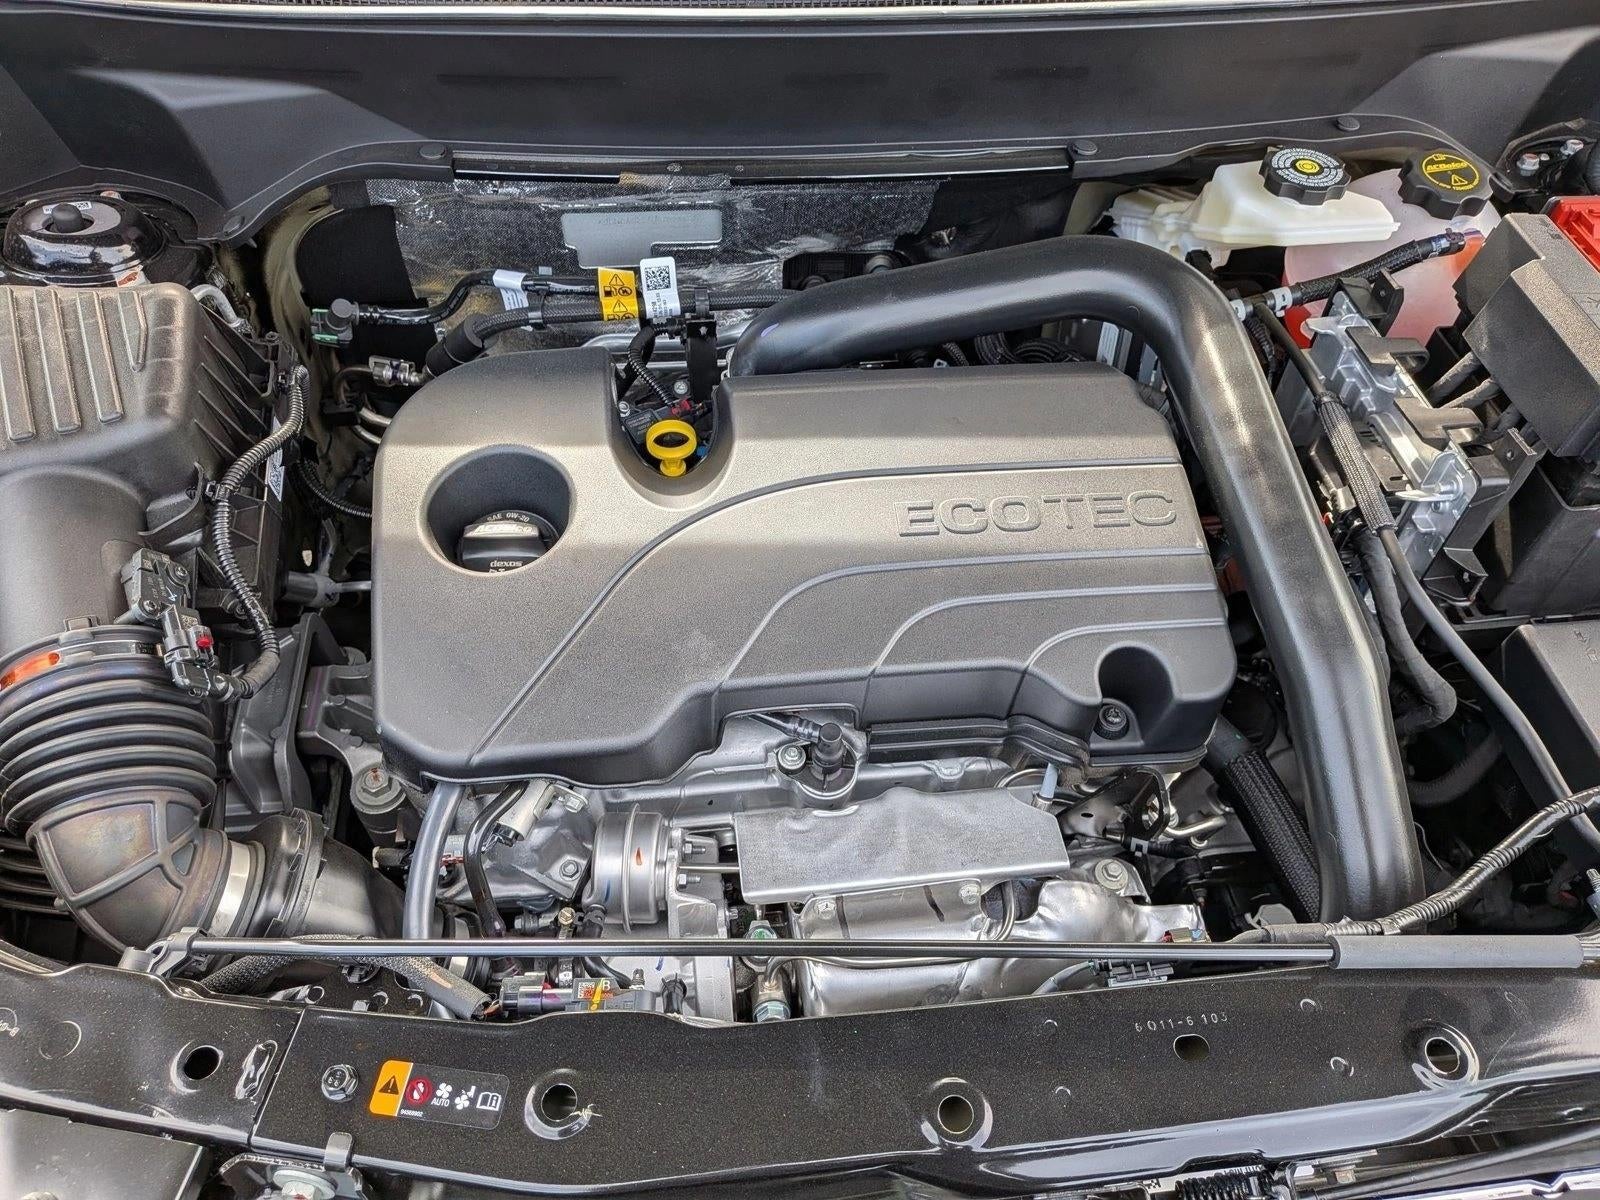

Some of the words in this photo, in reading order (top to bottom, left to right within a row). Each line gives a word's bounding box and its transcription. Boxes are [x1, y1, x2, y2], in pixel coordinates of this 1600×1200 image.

[487, 513, 502, 522] SAE
[894, 489, 1178, 537] ECOTEC
[490, 560, 523, 568] dexos
[430, 1097, 450, 1107] AUTO
